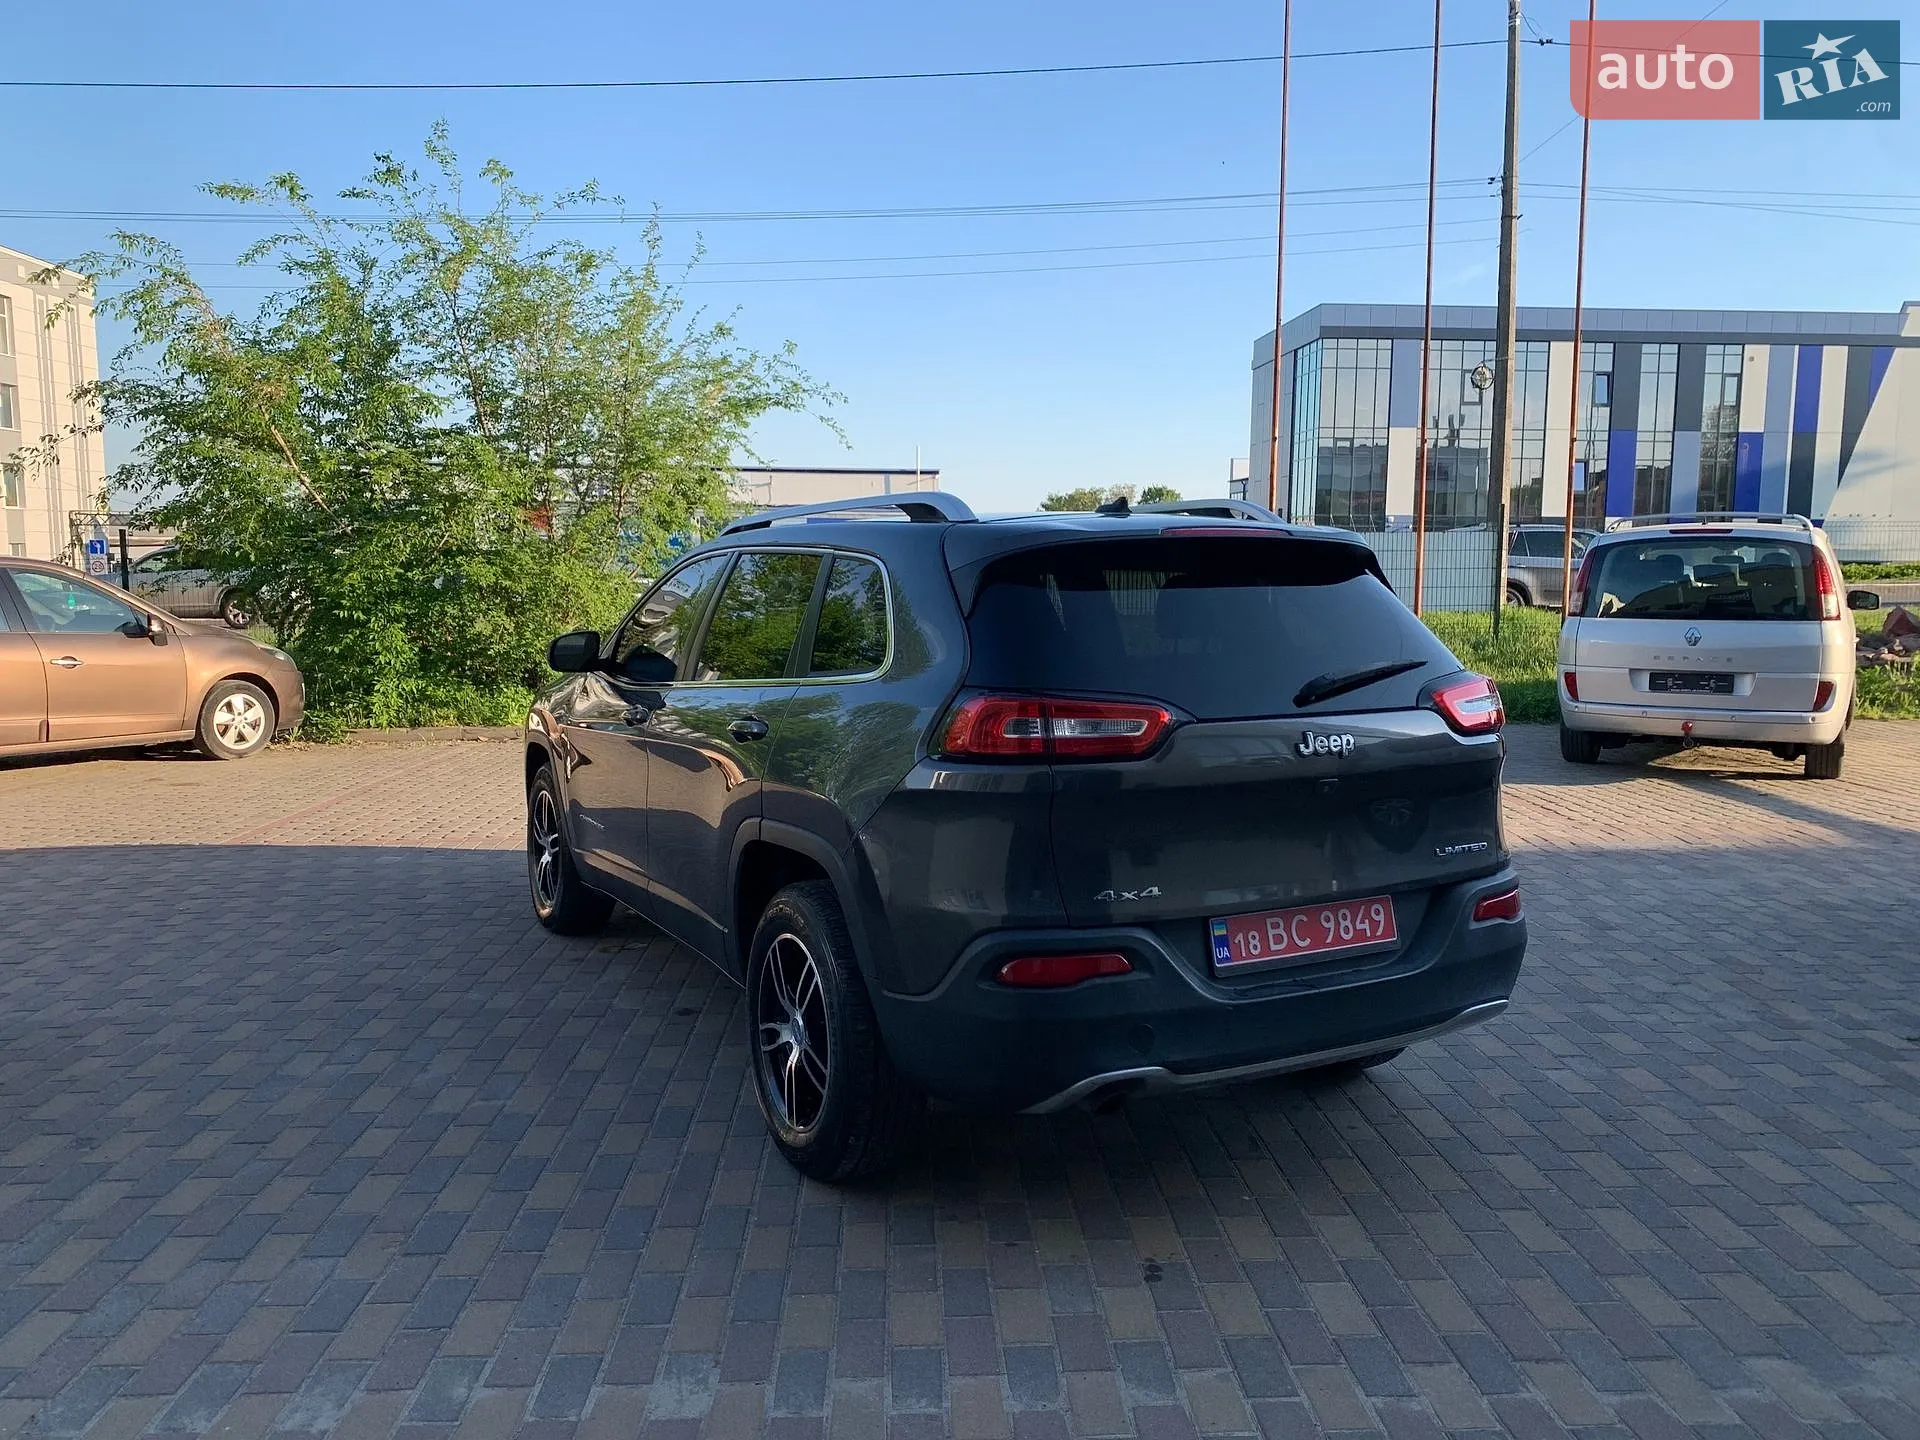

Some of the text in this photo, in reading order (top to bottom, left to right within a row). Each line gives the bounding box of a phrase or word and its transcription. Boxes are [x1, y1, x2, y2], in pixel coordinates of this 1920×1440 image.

[1299, 731, 1355, 758] Jeep
[1435, 842, 1488, 857] LIMITED
[1093, 886, 1162, 902] 4x4
[1233, 903, 1385, 957] 18 BC 9849
[1216, 946, 1231, 959] UA
